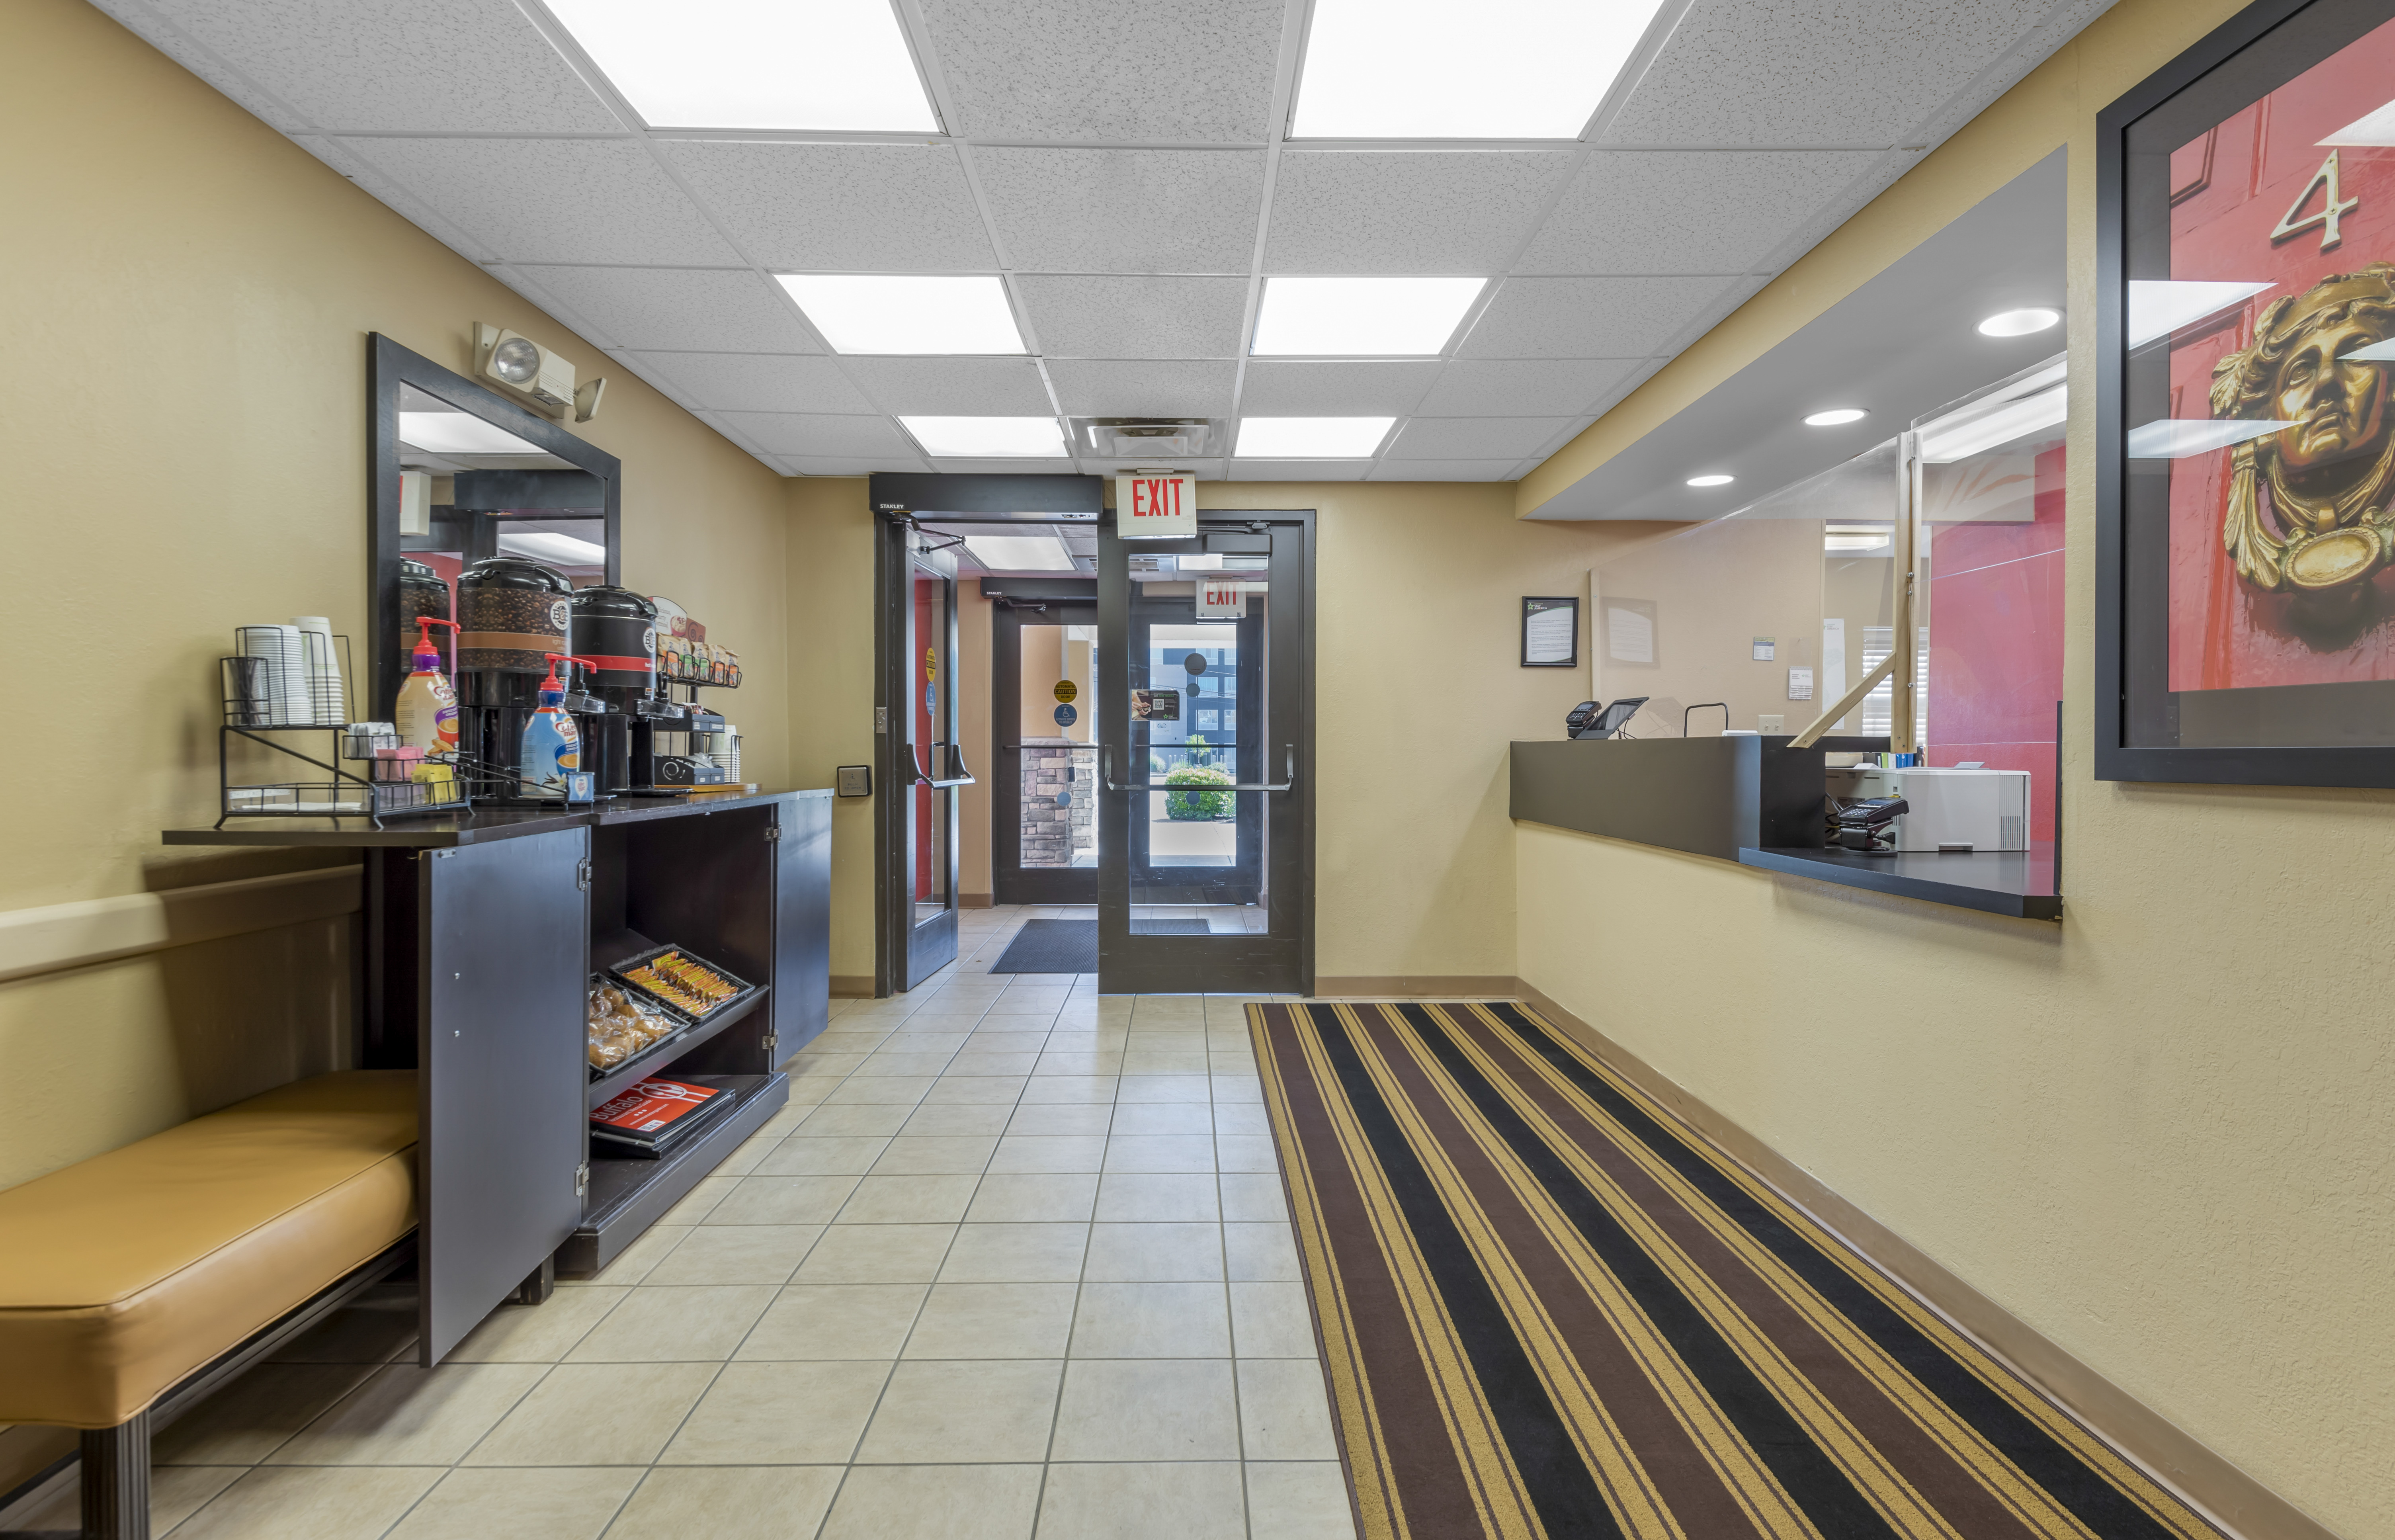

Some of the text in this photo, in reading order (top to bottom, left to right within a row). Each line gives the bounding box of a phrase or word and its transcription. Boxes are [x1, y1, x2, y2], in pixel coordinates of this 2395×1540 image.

[2270, 149, 2359, 250] 4
[1132, 479, 1184, 517] EXIT
[1206, 581, 1239, 605] EXIT
[589, 1096, 643, 1120] Buffalo
